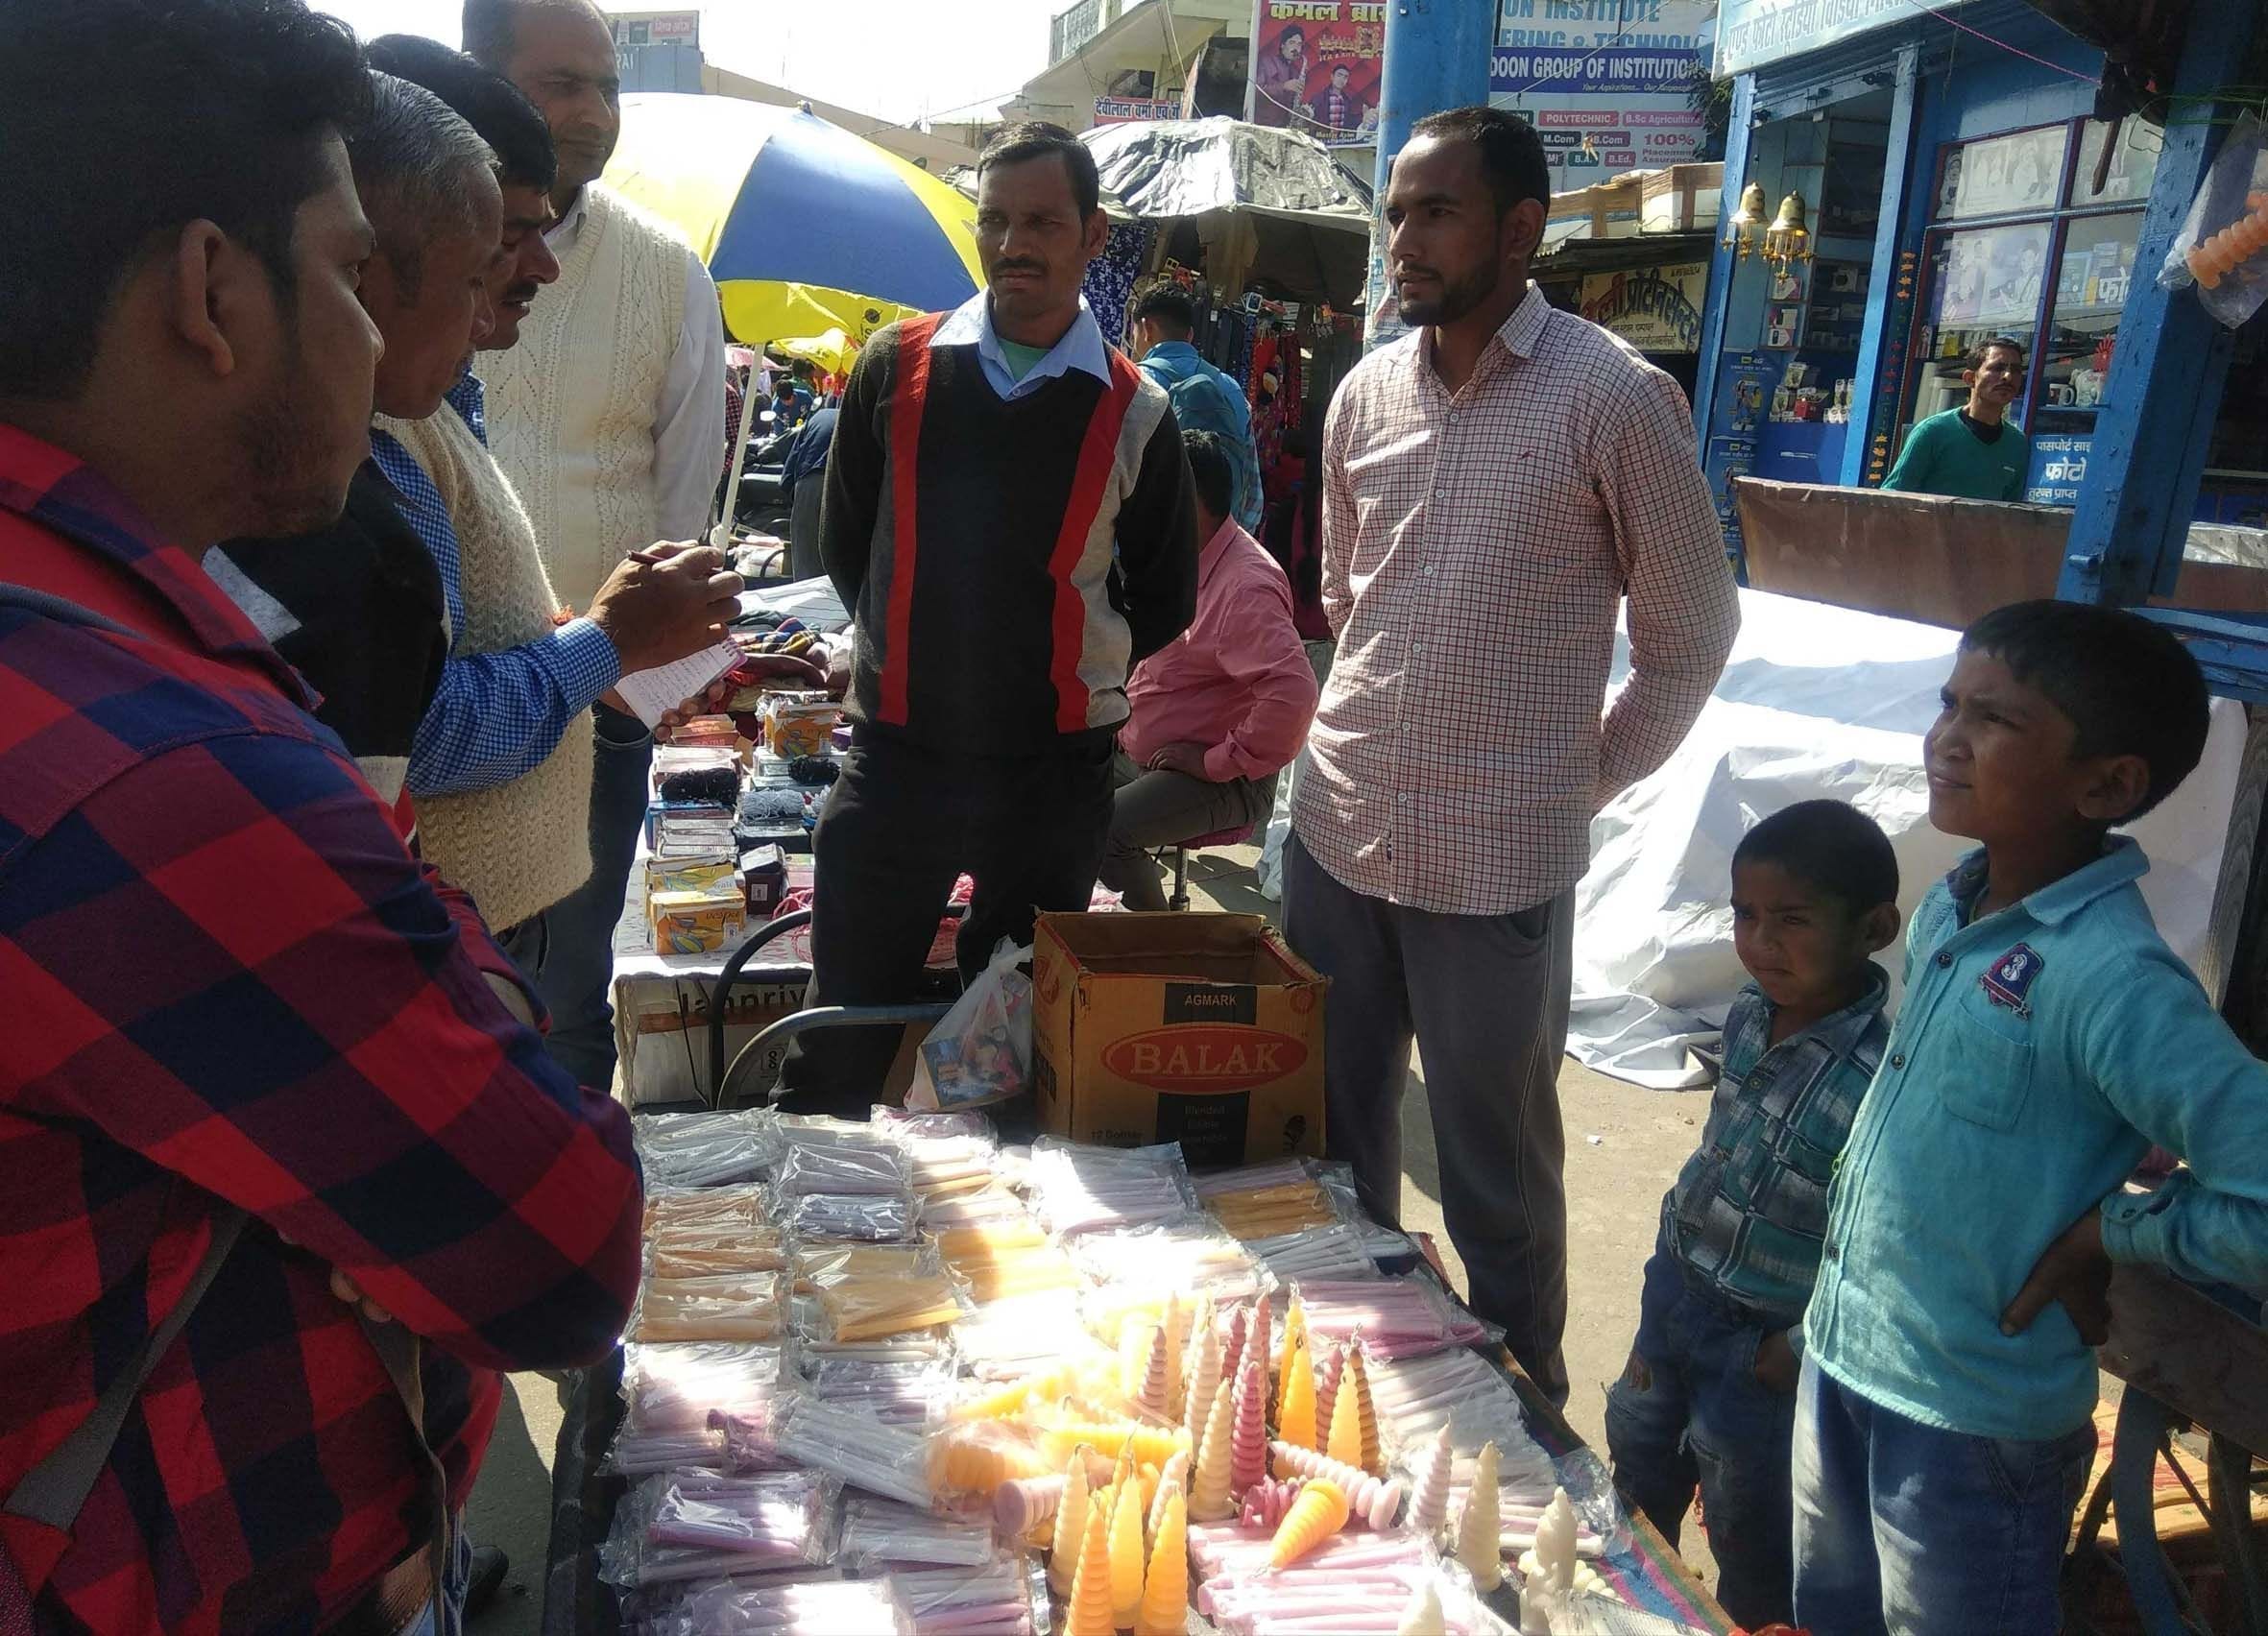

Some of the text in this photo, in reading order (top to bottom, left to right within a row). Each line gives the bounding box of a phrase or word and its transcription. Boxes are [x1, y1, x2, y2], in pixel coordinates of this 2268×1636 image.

[1269, 1, 1341, 21] कमल
[1544, 0, 1660, 22] INSTITUTE
[1533, 57, 1583, 79] GROUP
[1586, 58, 1605, 79] OF
[1546, 114, 1610, 123] POLYTECHNIC
[1543, 134, 1575, 143] M.Com
[1644, 133, 1695, 146] 100%
[2098, 266, 2131, 304] फो
[2036, 438, 2072, 452] पासपोर्ट
[2045, 456, 2087, 481] फोटो
[1184, 994, 1238, 1007] AGMARK
[1129, 1042, 1285, 1075] BALAK
